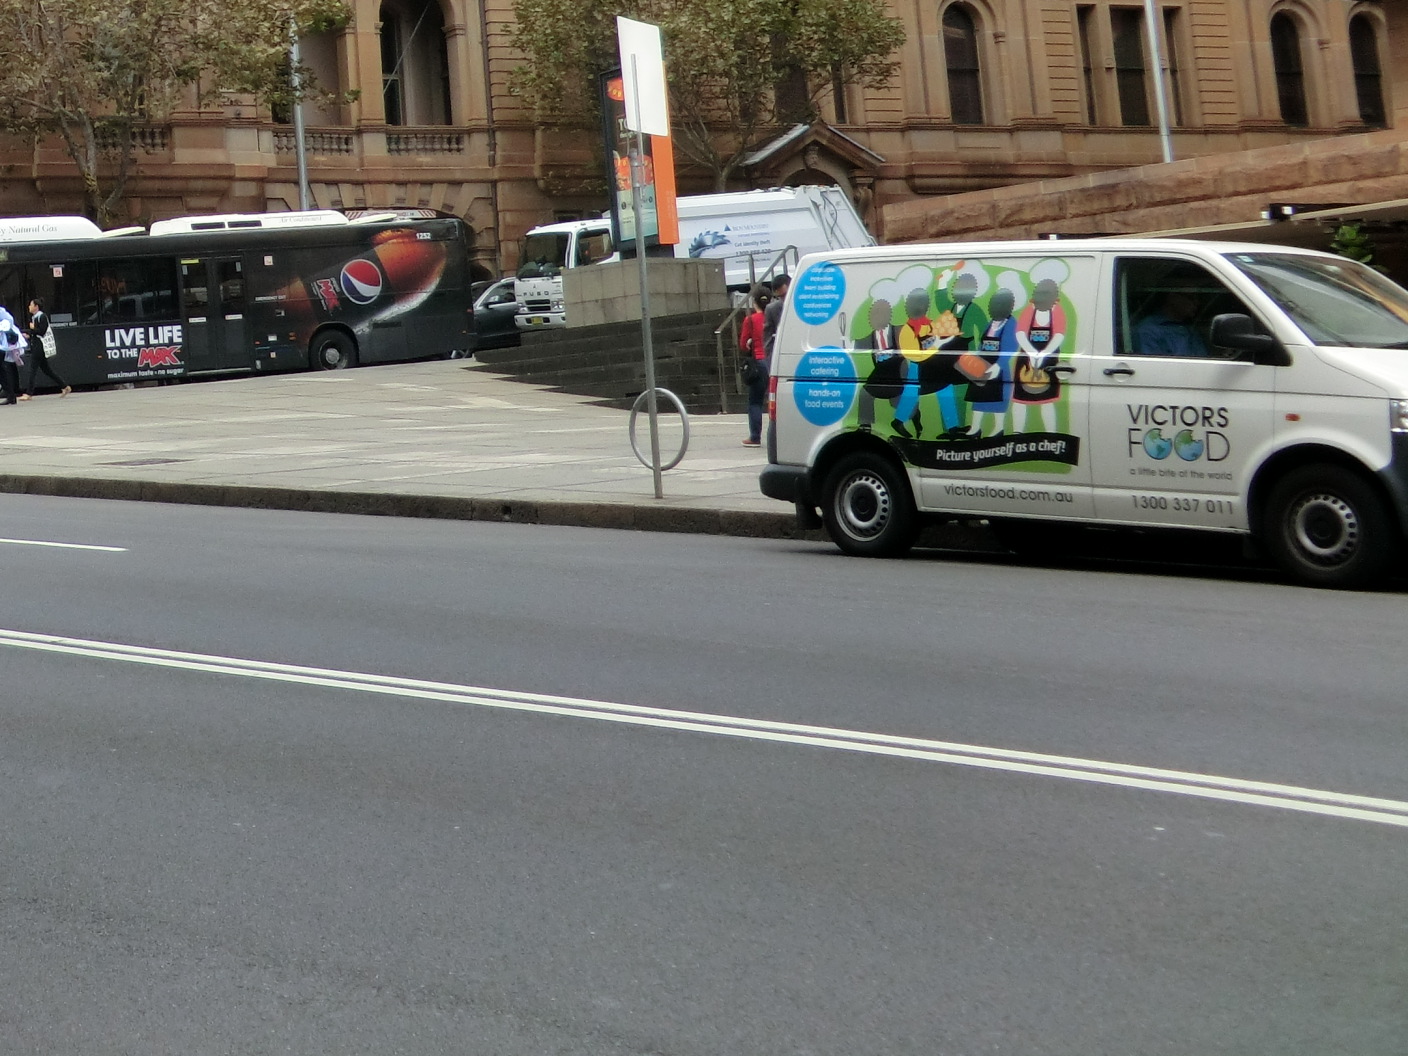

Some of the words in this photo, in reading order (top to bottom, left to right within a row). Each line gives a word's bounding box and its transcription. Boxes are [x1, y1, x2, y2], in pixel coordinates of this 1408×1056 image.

[8, 224, 41, 235] Natural
[42, 224, 58, 233] Gas
[416, 232, 431, 240] 1252
[104, 327, 145, 347] LIVE
[148, 325, 183, 345] LIFE
[106, 349, 120, 359] TO
[121, 348, 138, 358] THE
[808, 356, 845, 364] interactive
[107, 371, 138, 379] maximum
[139, 369, 154, 377] taste
[166, 368, 184, 376] sugar
[810, 367, 839, 377] catering
[808, 389, 841, 397] hands-on
[805, 400, 821, 408] food
[822, 400, 844, 408] events
[1127, 404, 1229, 428] VICTORS
[1128, 427, 1231, 462] FOOD
[936, 449, 971, 461] Picture
[973, 442, 1014, 463] yourself
[1016, 443, 1028, 453] as
[1029, 442, 1037, 452] a
[1038, 439, 1066, 454] chef!
[1129, 468, 1136, 476] a
[1138, 467, 1157, 477] little
[1159, 467, 1176, 477] bite
[1179, 468, 1189, 477] of
[1190, 469, 1205, 479] the
[1207, 471, 1233, 481] world
[944, 483, 1074, 503] victorsfood.com.au
[1132, 494, 1168, 511] 1300
[1172, 497, 1200, 513] 337
[1206, 499, 1234, 515] 011
